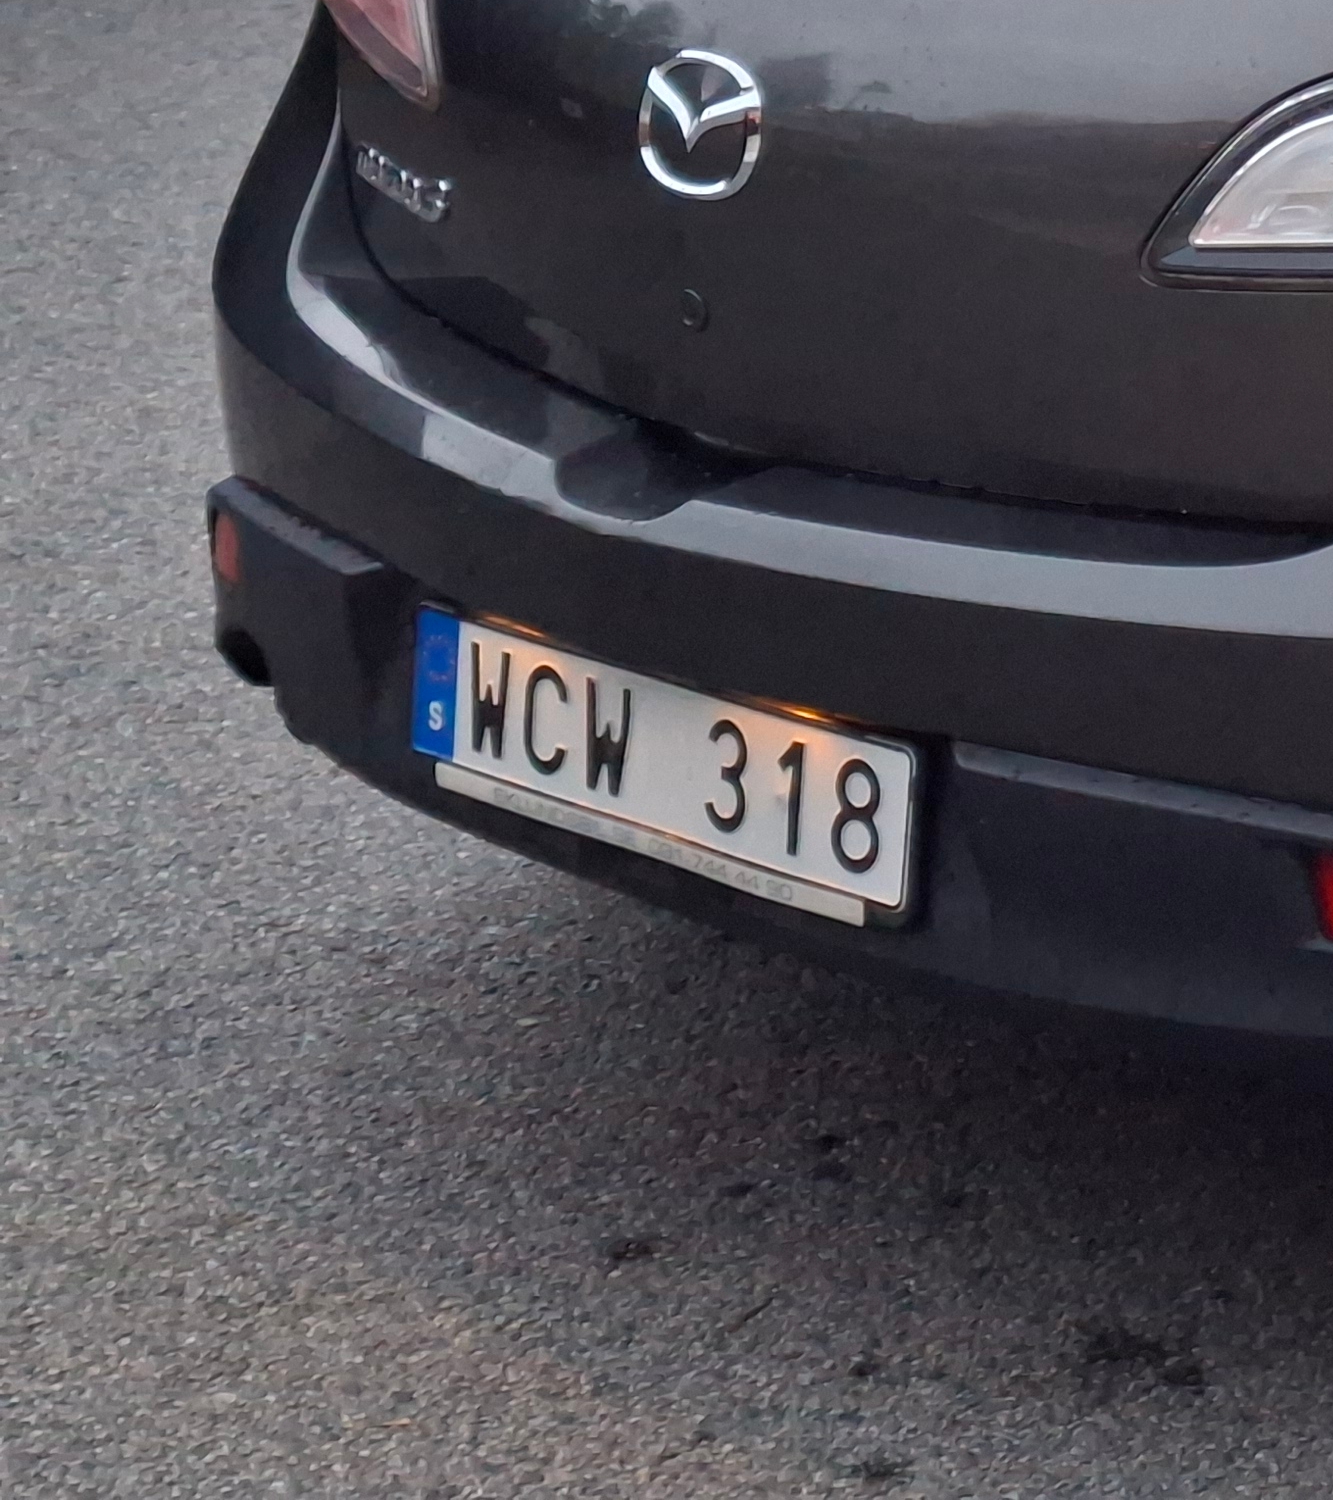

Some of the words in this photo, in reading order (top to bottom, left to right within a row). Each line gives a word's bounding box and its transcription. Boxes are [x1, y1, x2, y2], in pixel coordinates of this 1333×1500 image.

[427, 702, 443, 731] S
[470, 641, 632, 799] WCW
[704, 718, 882, 875] 318
